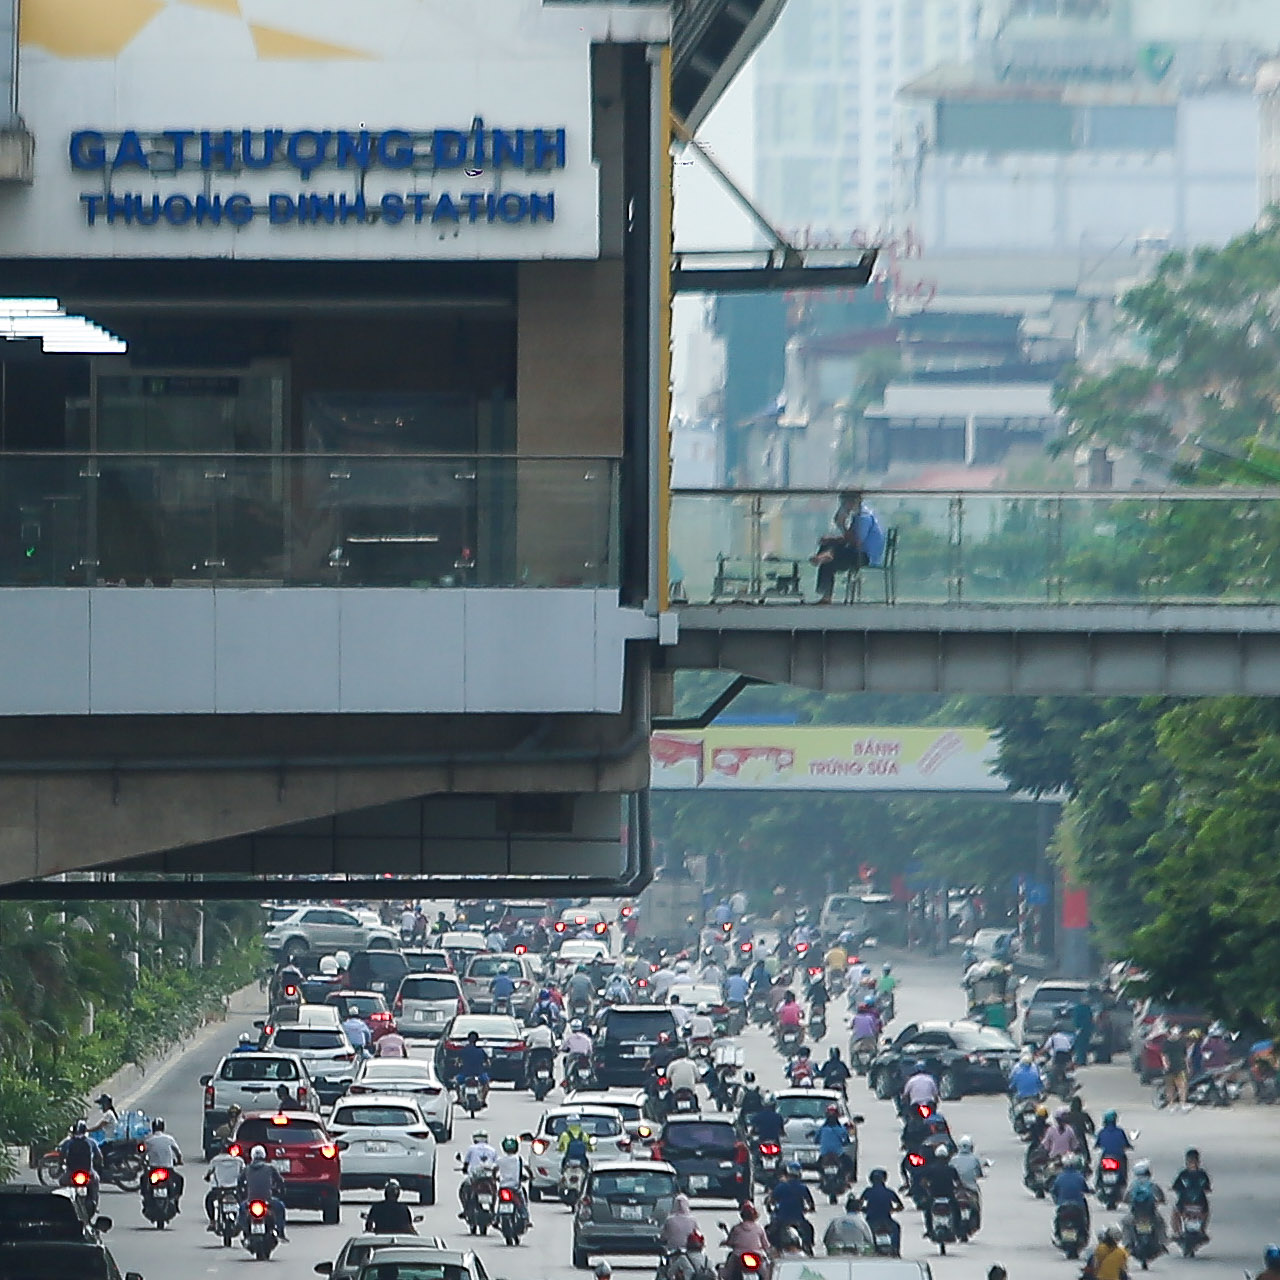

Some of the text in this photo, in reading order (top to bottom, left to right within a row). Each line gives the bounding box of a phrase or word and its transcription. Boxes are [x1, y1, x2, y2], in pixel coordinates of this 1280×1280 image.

[69, 129, 149, 171] GA
[80, 192, 556, 226] THUONG DINH STATION
